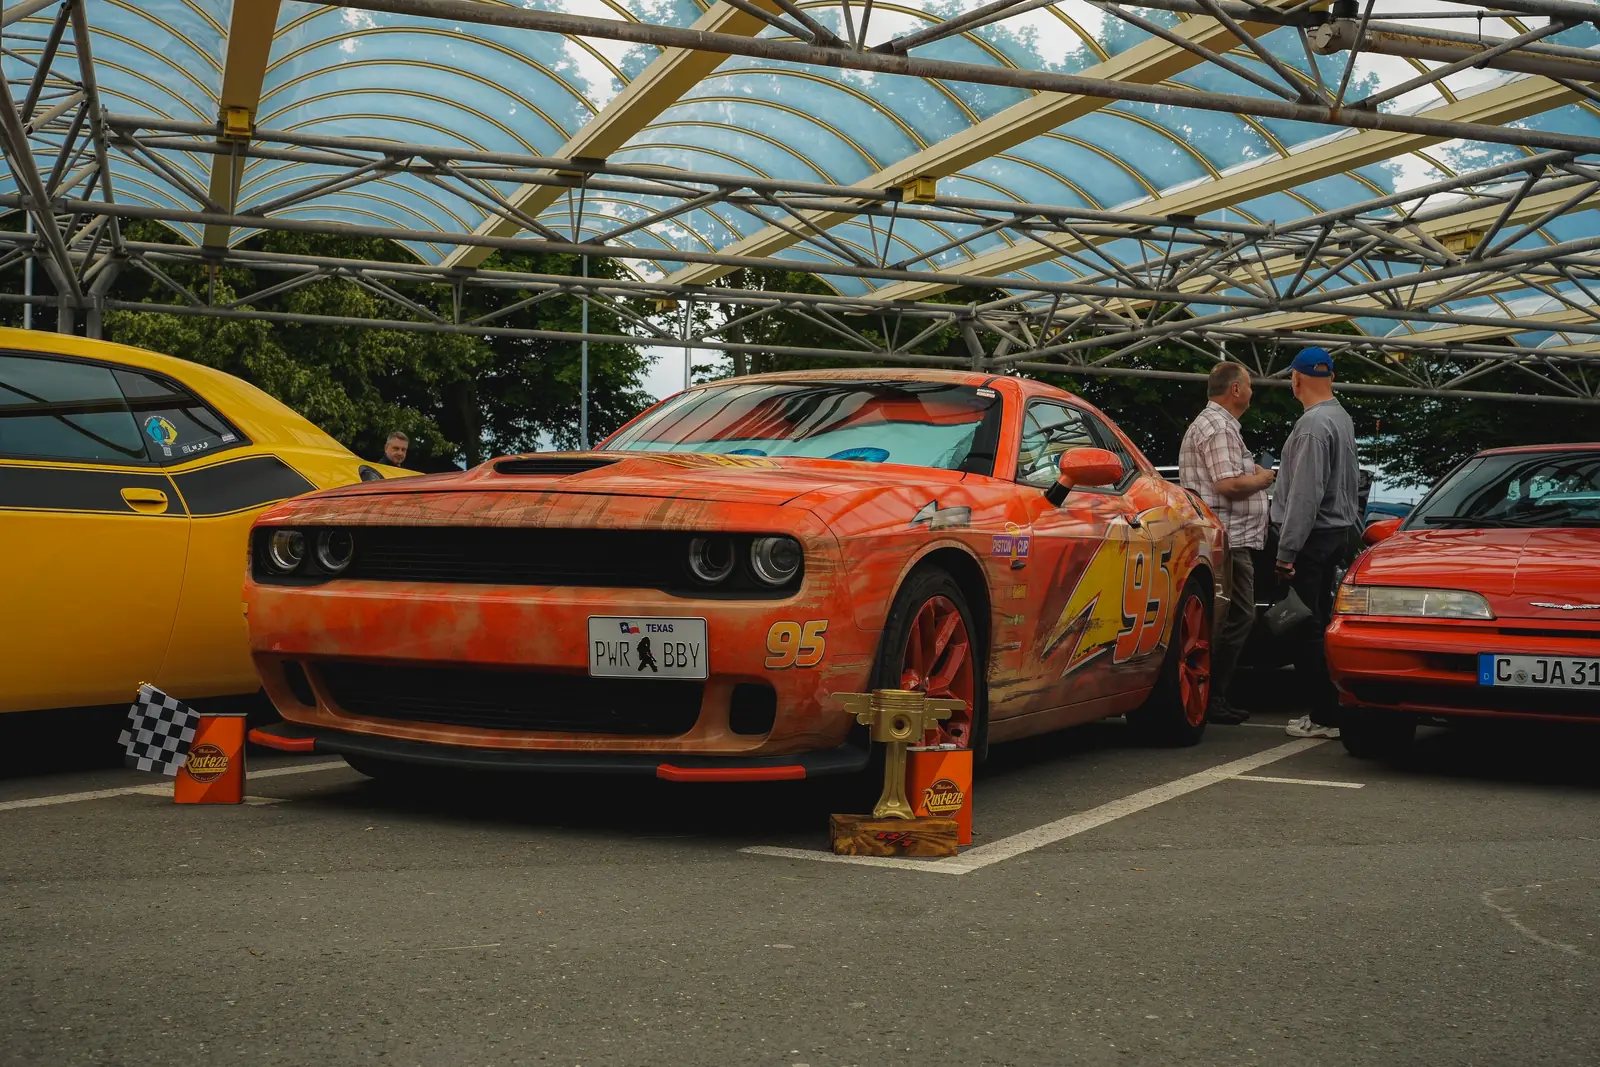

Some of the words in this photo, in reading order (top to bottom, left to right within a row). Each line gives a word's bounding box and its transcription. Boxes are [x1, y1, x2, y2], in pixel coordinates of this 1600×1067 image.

[992, 540, 1012, 552] PISTON
[1017, 540, 1029, 552] CUP
[1112, 505, 1173, 664] 95
[646, 623, 674, 633] TEXAS
[595, 640, 631, 667] PWR
[662, 641, 700, 668] BBY
[763, 619, 829, 670] 95
[1496, 658, 1512, 682] C
